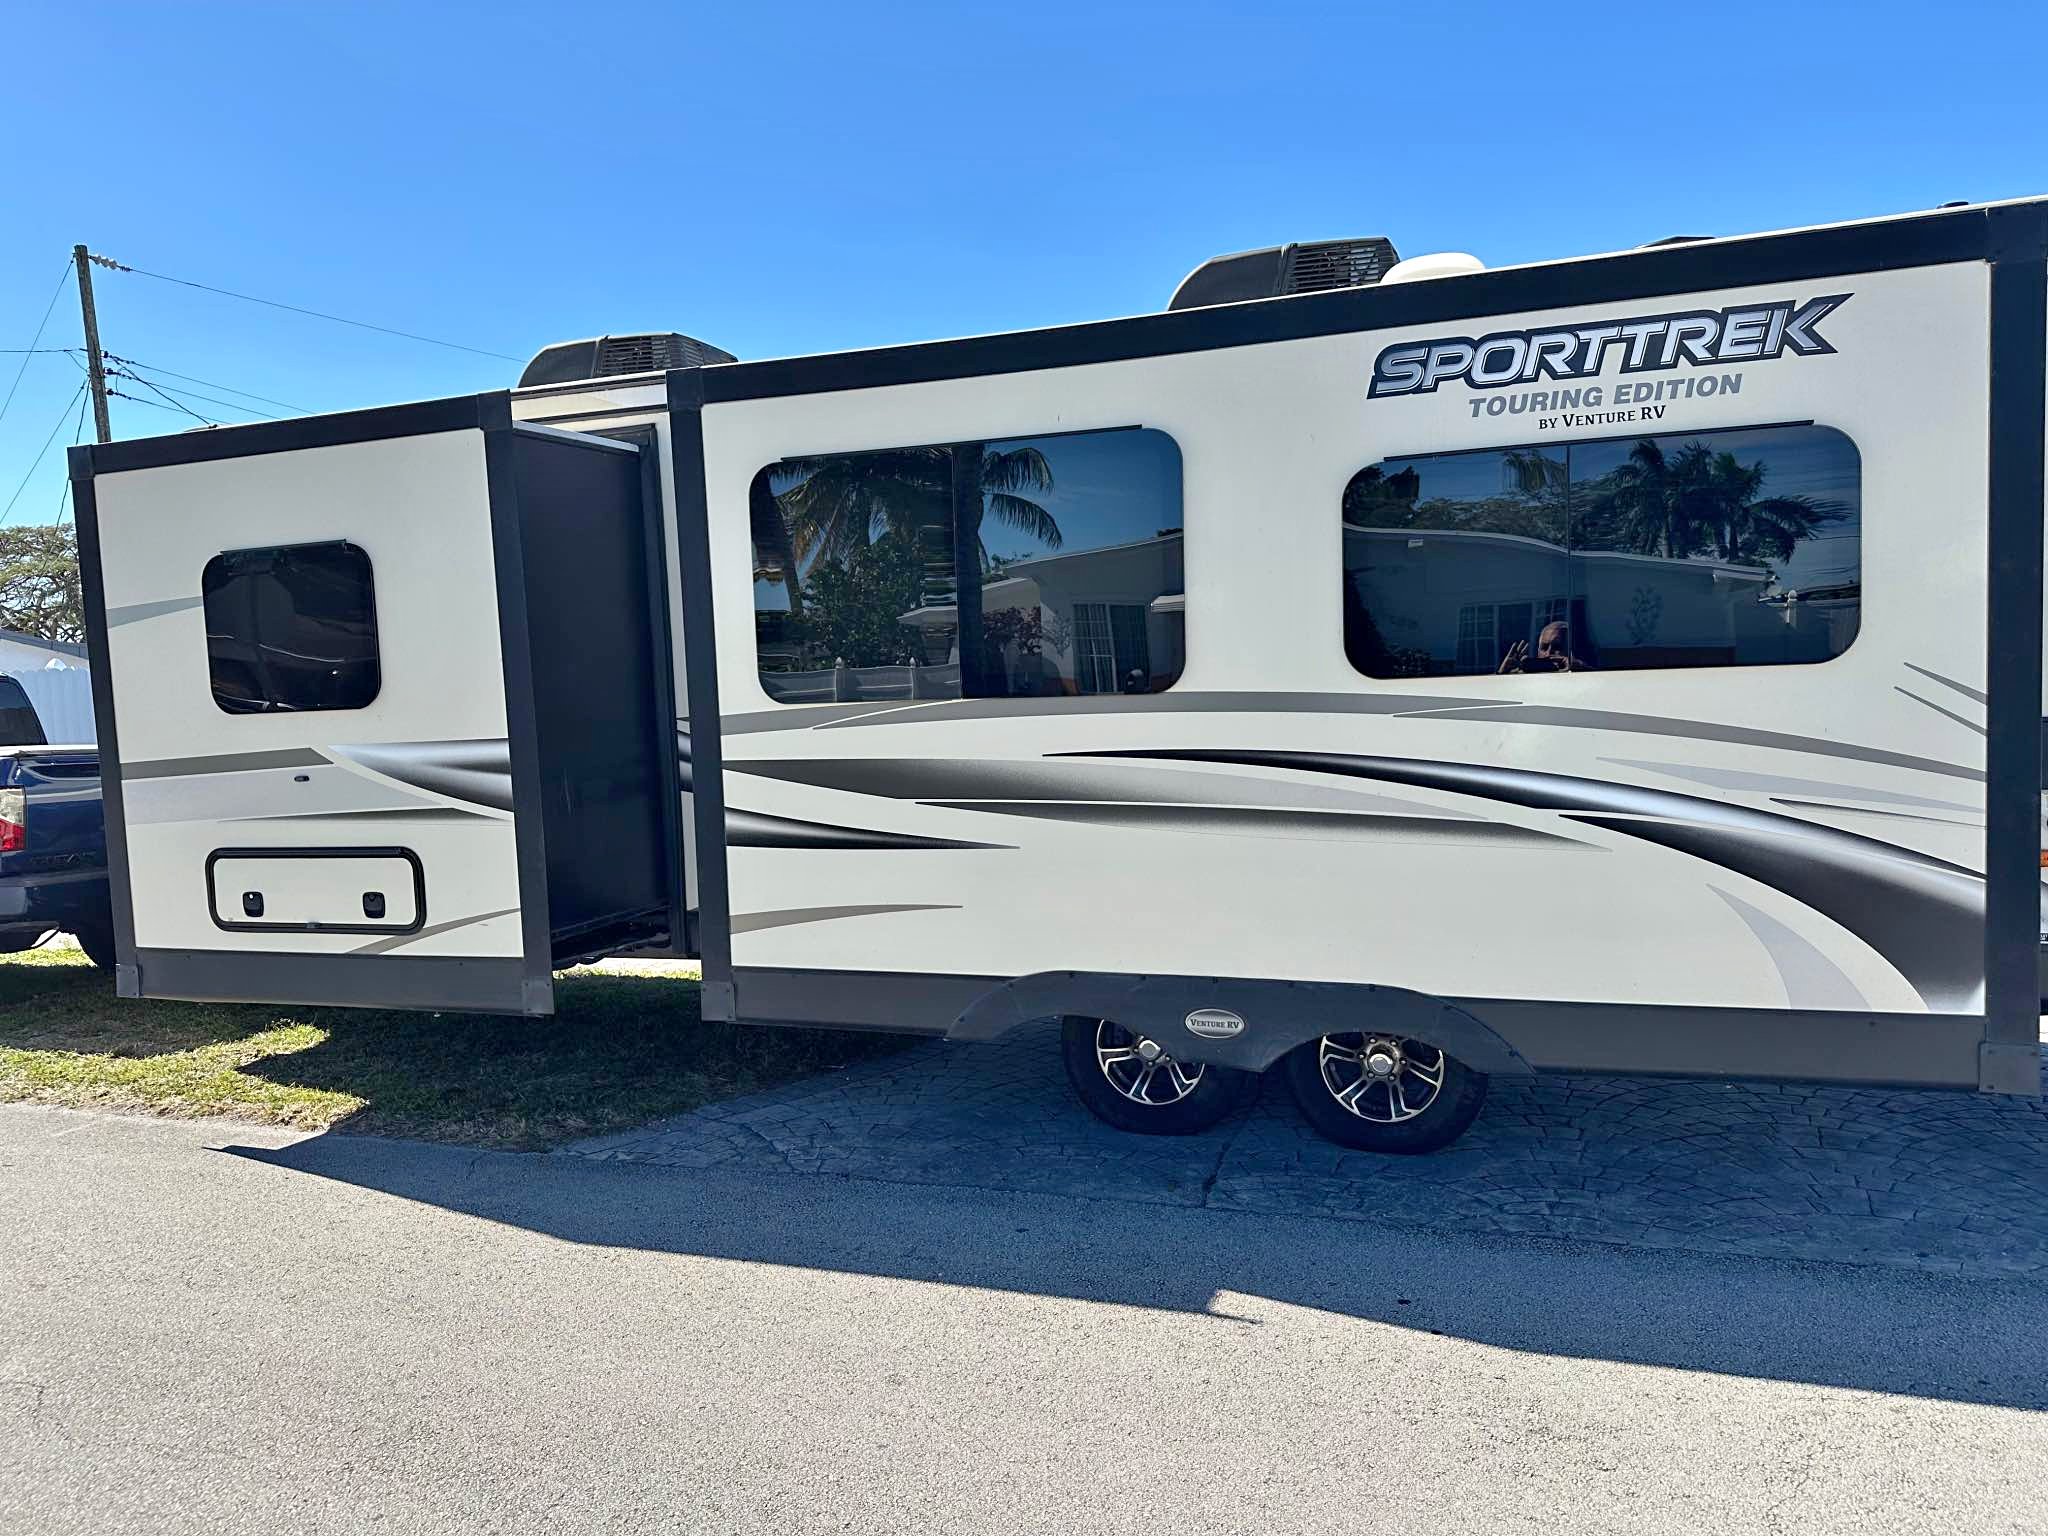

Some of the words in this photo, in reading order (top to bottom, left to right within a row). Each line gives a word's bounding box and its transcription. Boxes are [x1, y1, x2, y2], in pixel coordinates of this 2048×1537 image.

[1368, 293, 1854, 399] SPORTTREK
[1469, 387, 1603, 418] TOURING
[1614, 373, 1742, 405] EDITION
[1641, 405, 1666, 420] RV
[1227, 1021, 1240, 1029] RV
